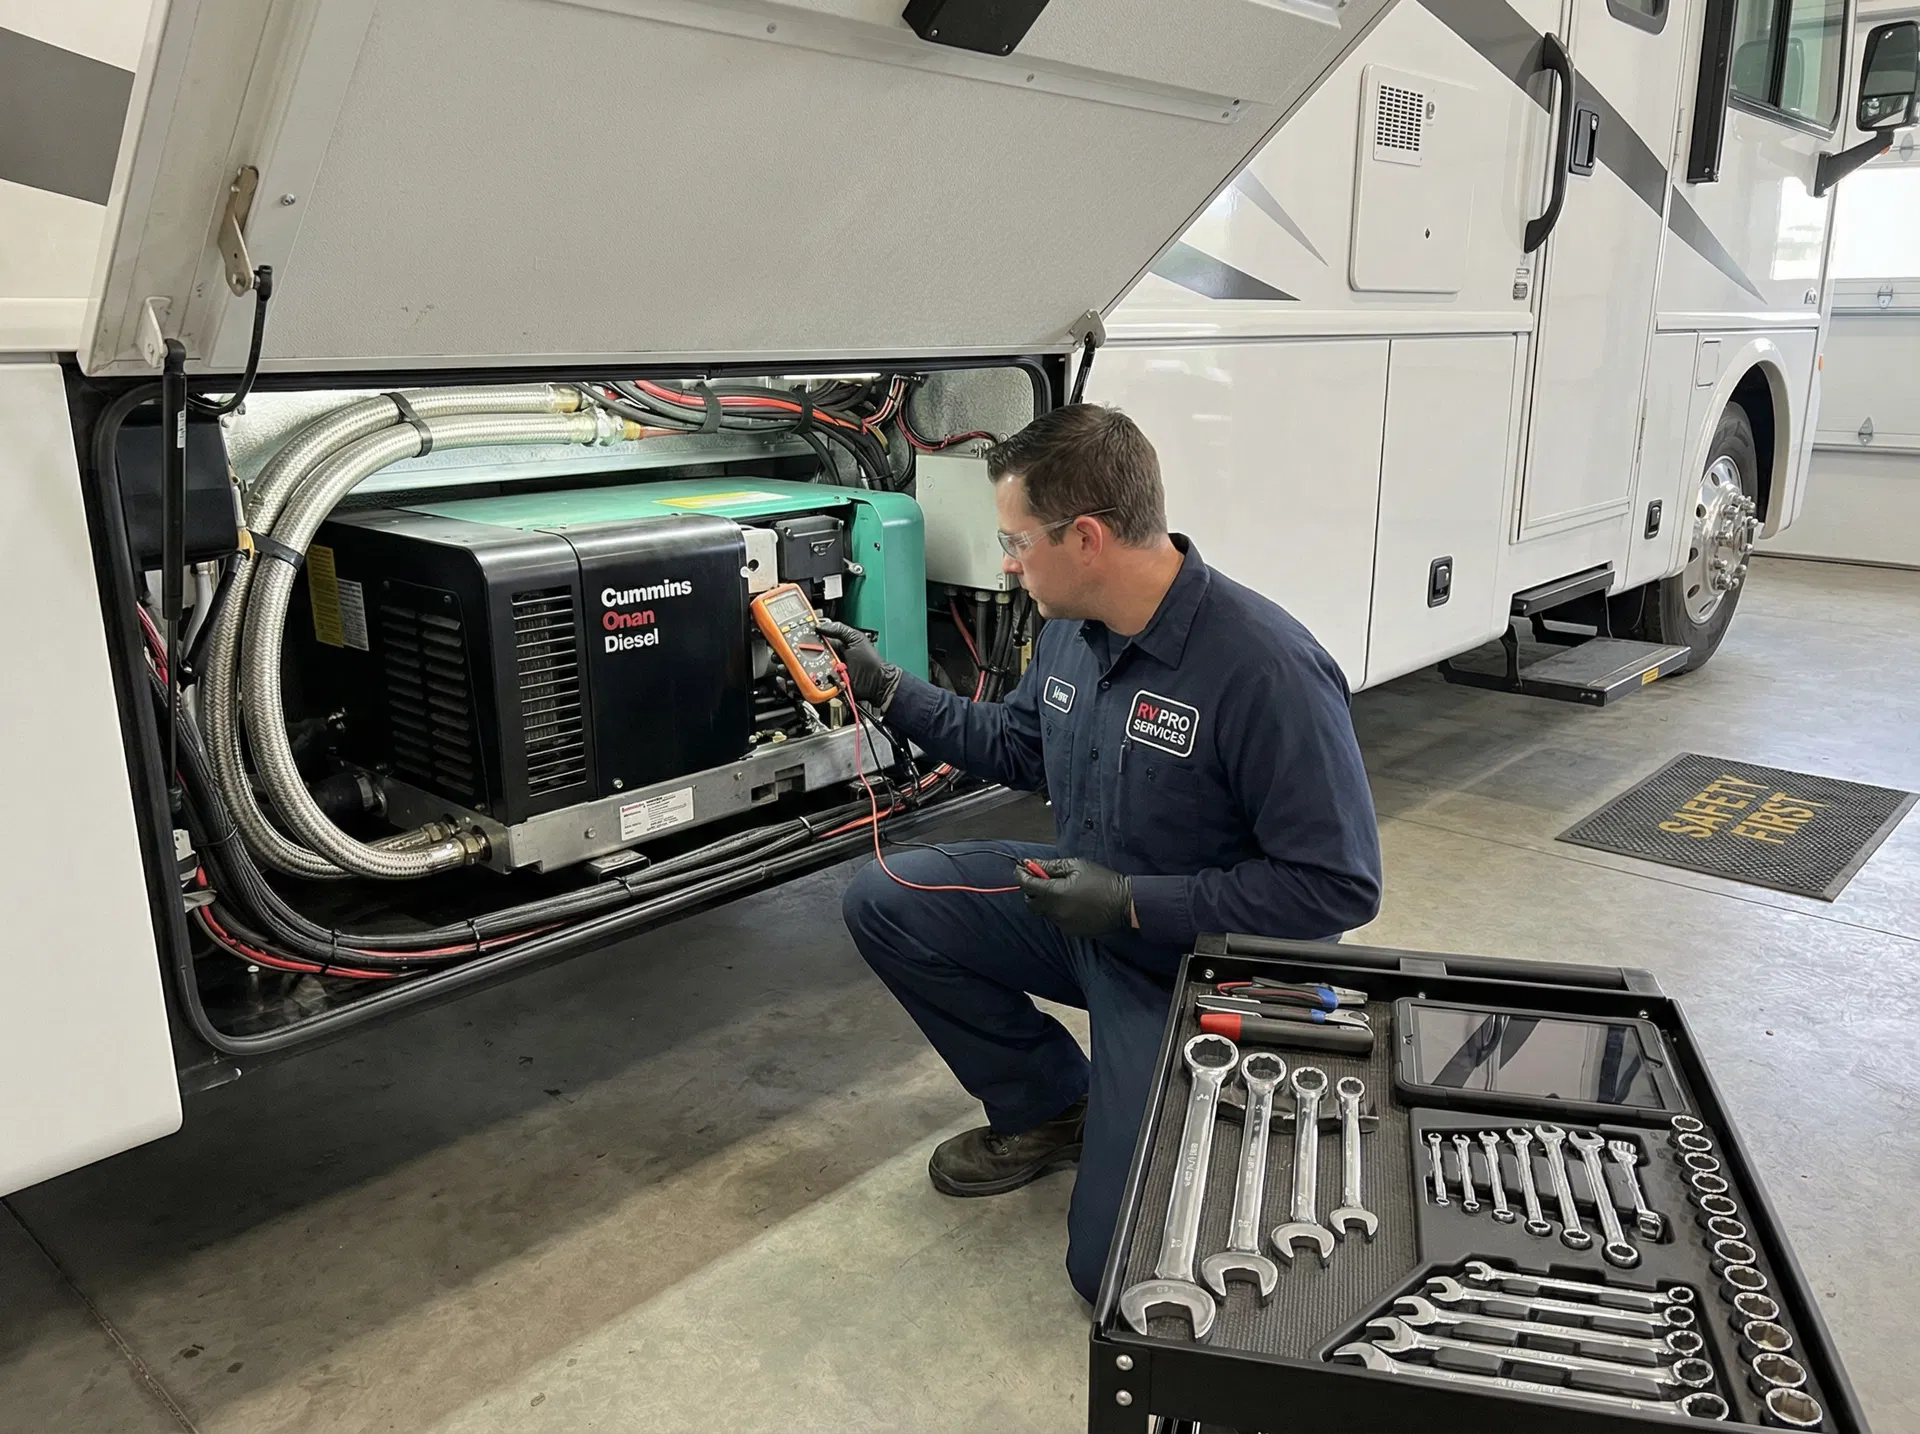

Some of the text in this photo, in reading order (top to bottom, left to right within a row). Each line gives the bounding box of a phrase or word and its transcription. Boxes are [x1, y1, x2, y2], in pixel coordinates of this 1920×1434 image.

[601, 579, 692, 607] Cummins
[602, 609, 655, 630] Onan
[604, 628, 659, 653] Diesel
[1133, 719, 1186, 745] SERVICES
[1658, 774, 1769, 838] SAFETY
[1730, 792, 1830, 845] FIRST
